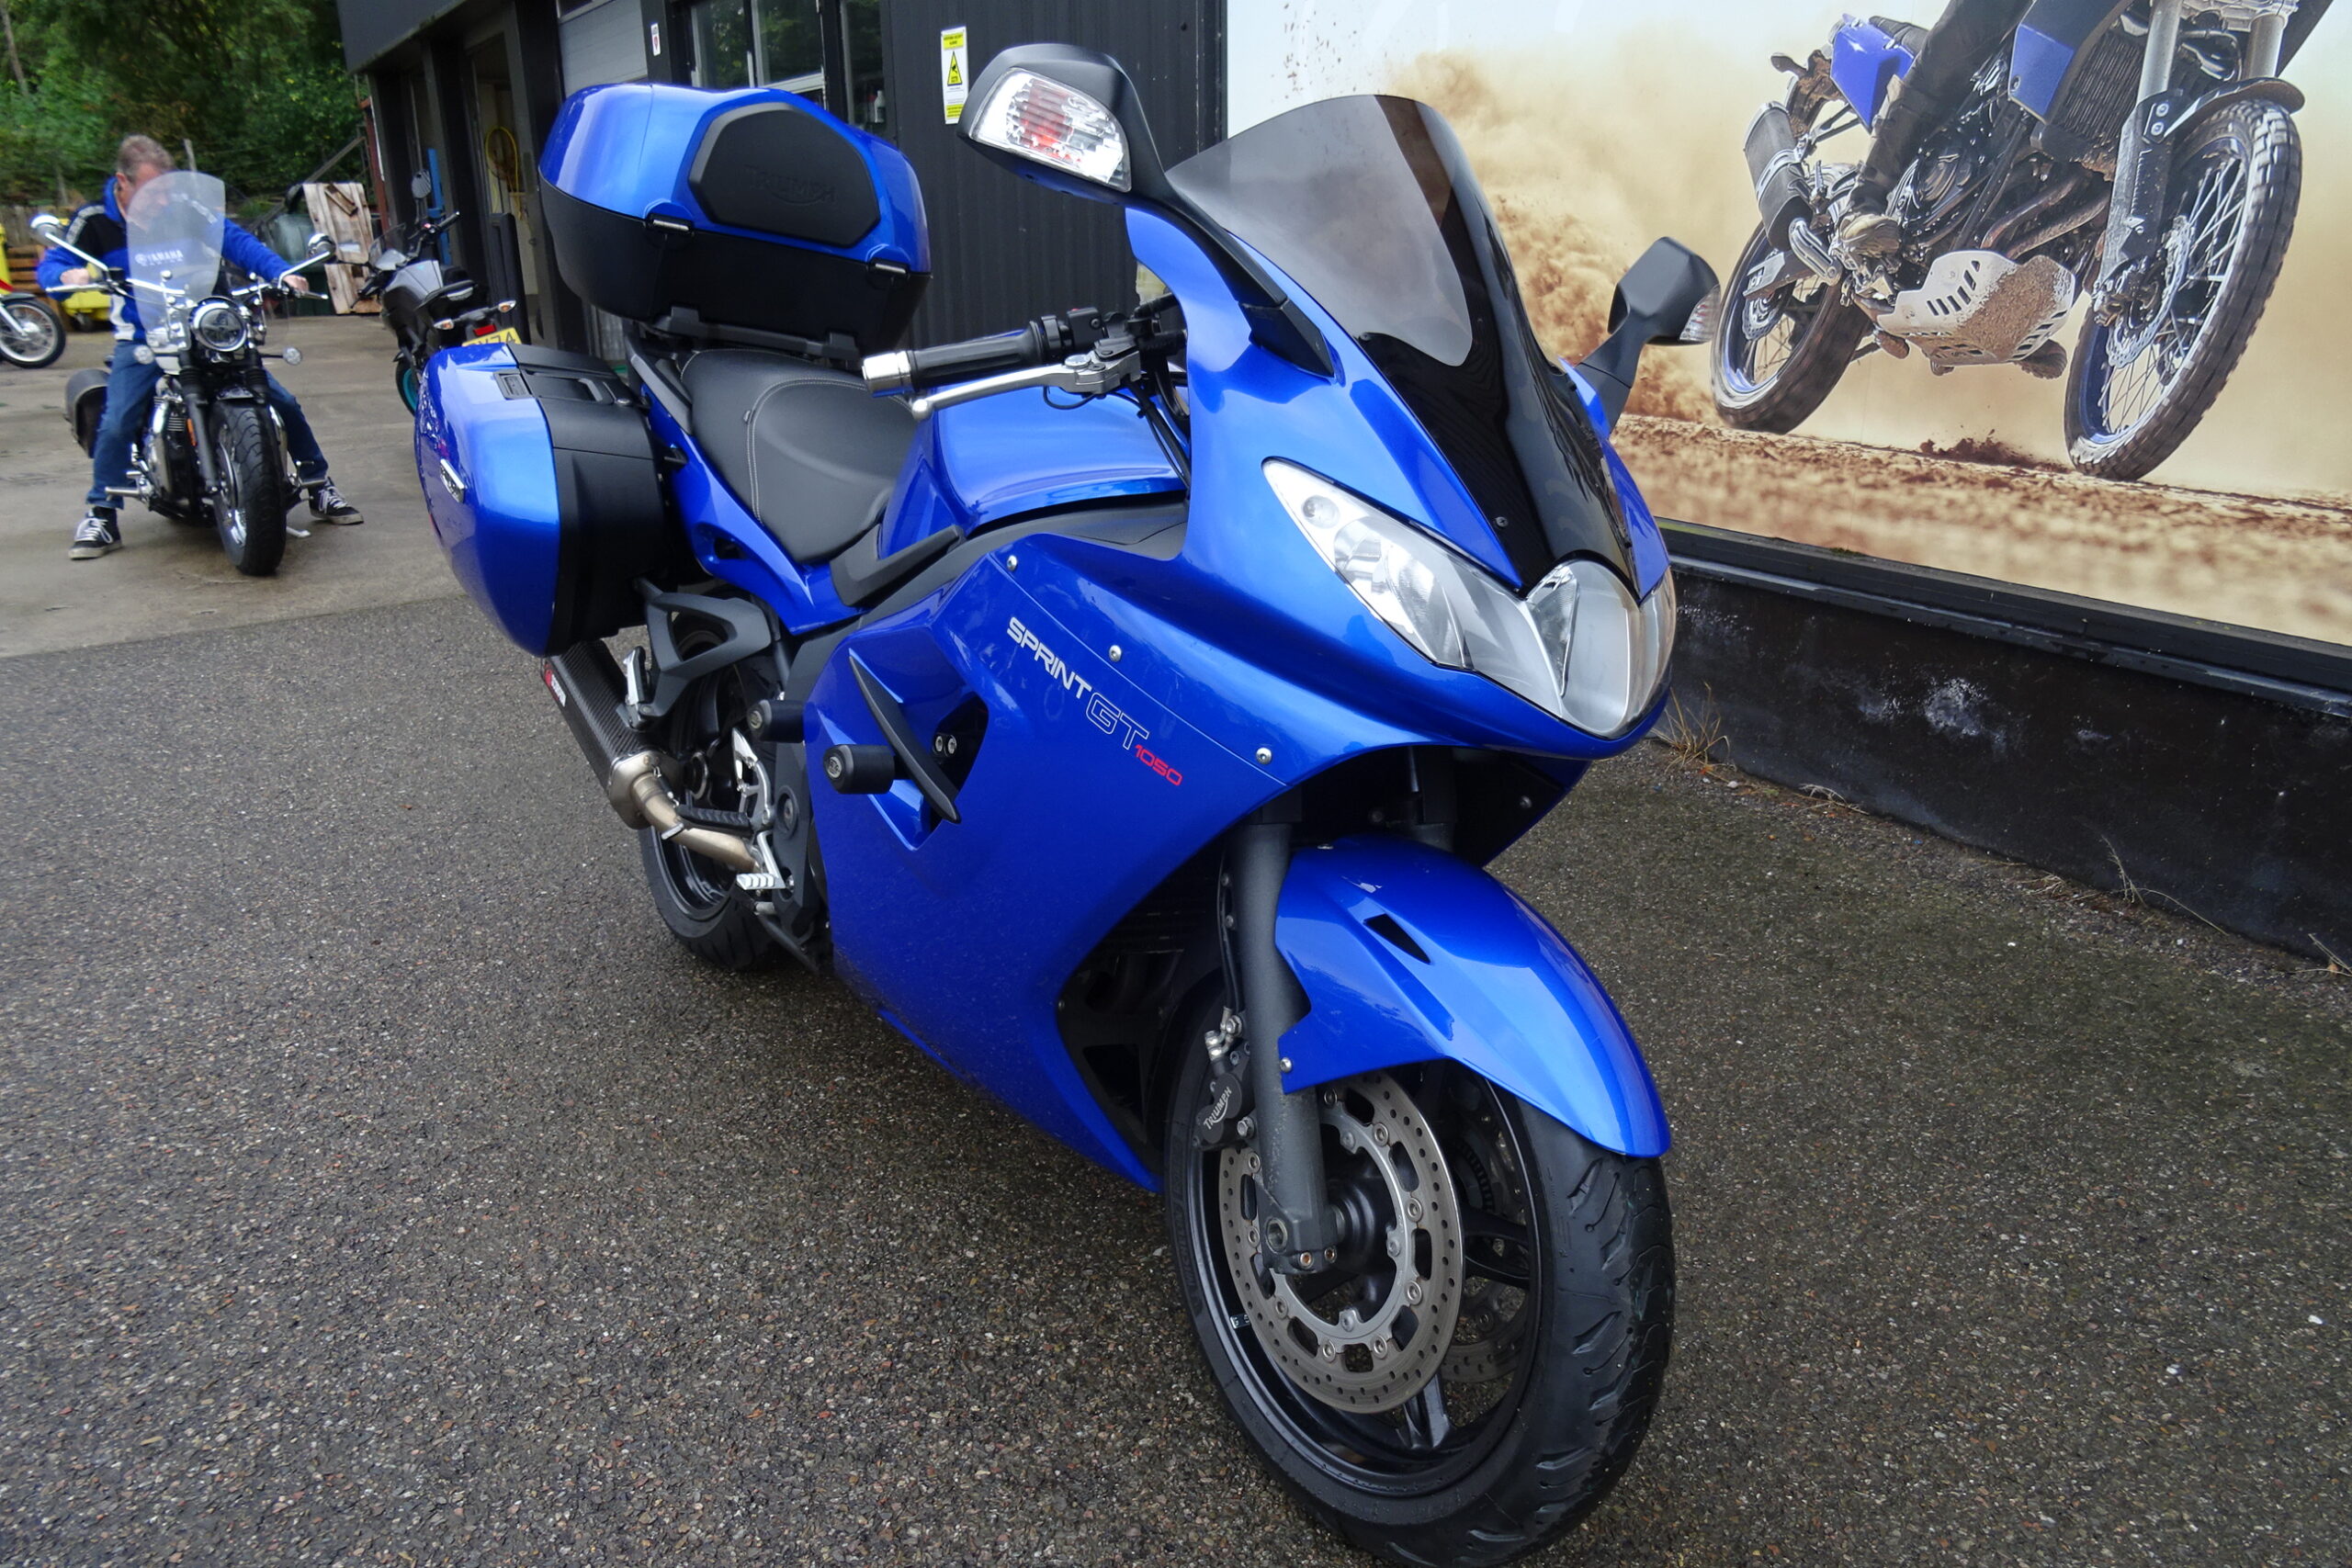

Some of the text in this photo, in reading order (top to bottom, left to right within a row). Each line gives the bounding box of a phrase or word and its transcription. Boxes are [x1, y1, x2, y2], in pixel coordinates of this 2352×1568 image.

[742, 164, 837, 206] TRIUMPH
[148, 250, 184, 262] YAMAHA
[1007, 616, 1183, 786] SPRINT GT 1050
[1203, 1086, 1232, 1130] TRIUMPH
